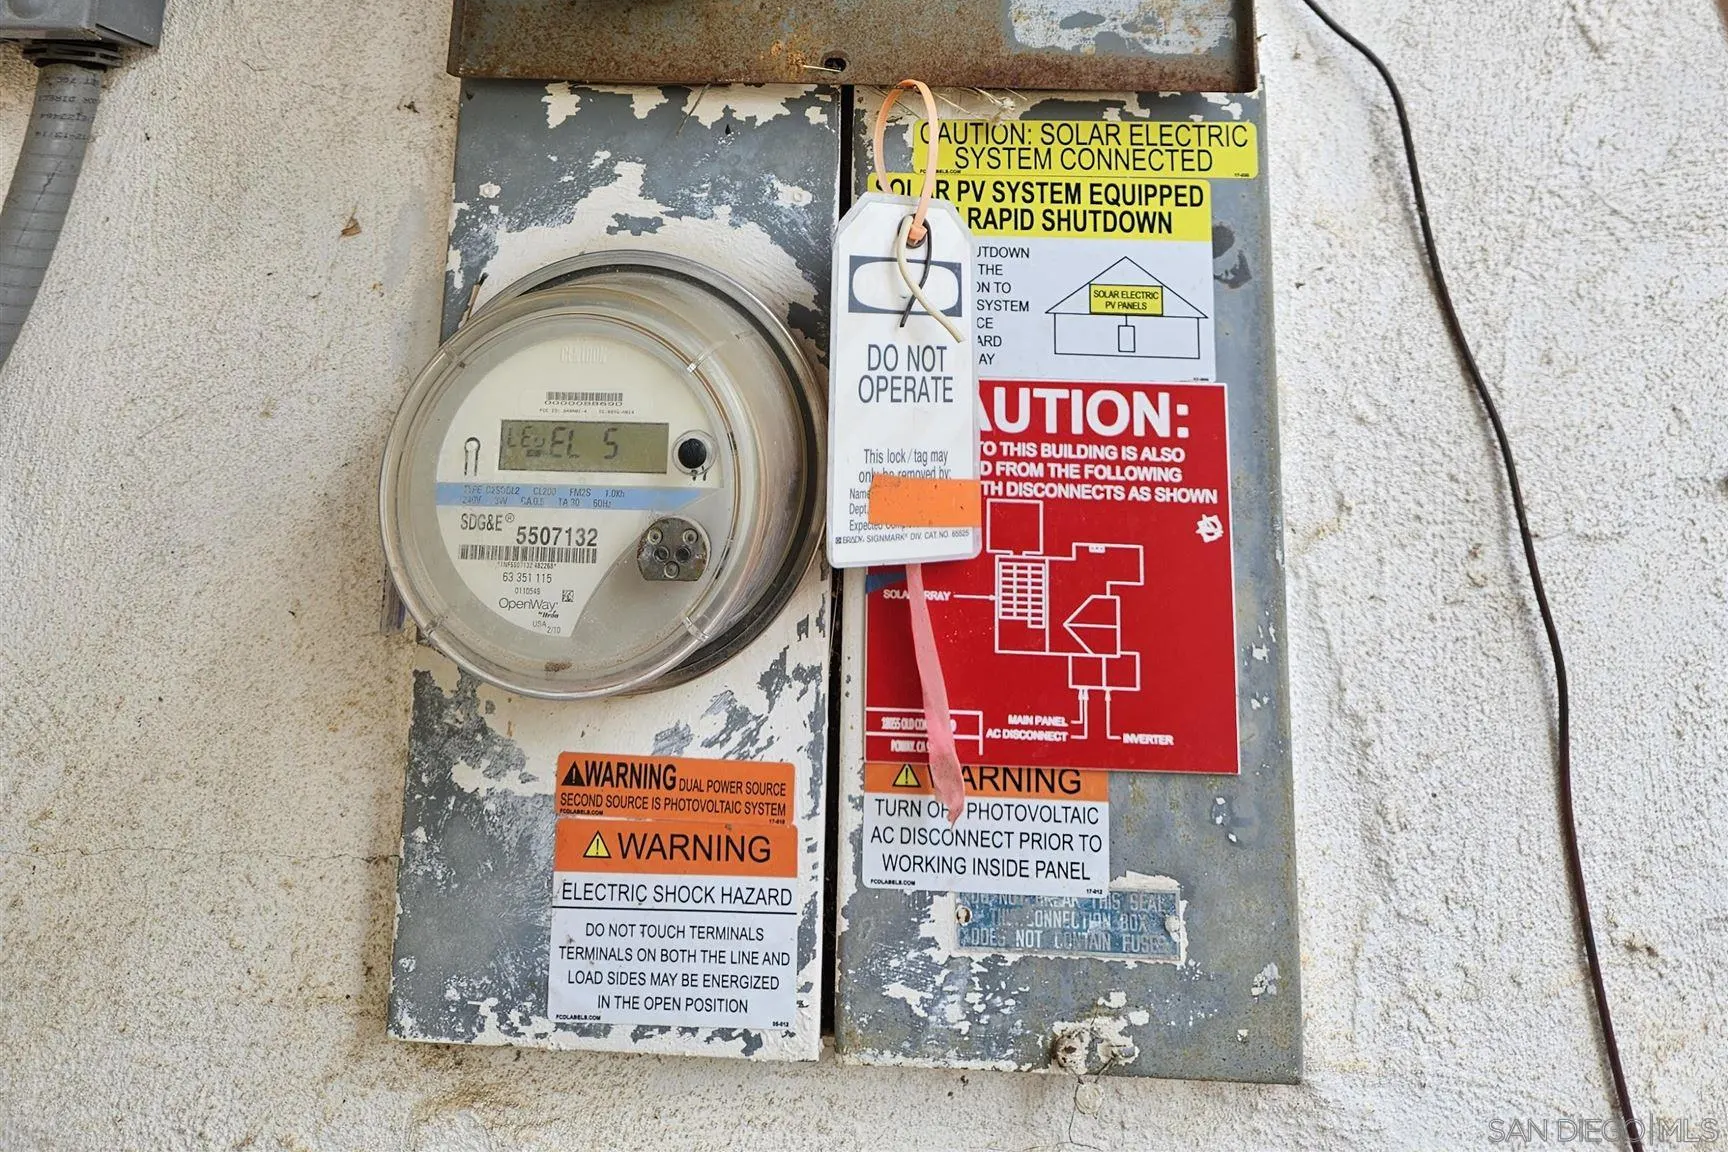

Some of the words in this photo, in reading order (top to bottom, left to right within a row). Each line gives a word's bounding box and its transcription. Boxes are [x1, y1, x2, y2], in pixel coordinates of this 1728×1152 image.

[920, 122, 1033, 145] CAUTION:
[1041, 122, 1126, 146] SOLAR
[1130, 124, 1249, 147] ELECTRIC
[955, 147, 1055, 170] SYSTEM
[1060, 149, 1213, 172] CONNECTED
[957, 181, 984, 202] PV
[992, 181, 1081, 205] SYSTEM
[1089, 183, 1204, 207] EQUIPPED
[968, 207, 1035, 230] RAPID
[1042, 209, 1173, 234] SHUTDOWN
[979, 264, 1003, 275] THE
[994, 282, 1011, 293] TO
[1093, 290, 1120, 299] SOLAR
[1121, 290, 1159, 300] ELECTRIC
[977, 300, 1030, 312] SYSTEM
[1105, 301, 1116, 309] PV
[1118, 302, 1147, 310] PANELS
[868, 344, 898, 372] DO
[907, 345, 947, 372] NOT
[858, 375, 953, 403] OPERATE
[979, 386, 1189, 439] AUTION:
[603, 427, 620, 460] 5
[1000, 442, 1037, 458] THIS
[1041, 443, 1118, 460] BUILDING
[1121, 446, 1138, 461] IS
[1140, 446, 1185, 463] ALSO
[864, 449, 883, 464] This
[887, 449, 905, 463] lock
[914, 450, 927, 466] tag
[931, 450, 948, 465] may
[859, 468, 875, 483] onl
[996, 462, 1044, 478] FROM
[1047, 463, 1081, 479] THE
[1084, 464, 1182, 482] FOLLOWING
[982, 481, 1003, 496] TH
[1006, 482, 1122, 501] DISCONNECTS
[1128, 488, 1152, 502] AS
[1155, 489, 1218, 504] SHOWN
[516, 526, 598, 547] 5507132
[503, 572, 513, 582] 63
[517, 573, 531, 582] 351
[883, 589, 910, 600] SOLA
[924, 590, 951, 601] RRAY
[1008, 714, 1033, 726] MAIN
[1035, 715, 1068, 726] PANEL
[986, 728, 1002, 739] AC
[1003, 729, 1068, 742] DISCONNECT
[1122, 733, 1174, 746] INVERTER
[585, 760, 677, 790] WARNING
[679, 779, 704, 792] DUAL
[707, 780, 743, 794] POWER
[745, 782, 787, 796] SOURCE
[930, 765, 1081, 794] ARNING
[560, 792, 603, 807] SECOND
[606, 795, 649, 810] SOURCE
[652, 798, 661, 810] IS
[664, 798, 741, 814] PHOTOVOLTAIC
[744, 803, 786, 817] SYSTEM
[875, 799, 921, 818] TURN
[967, 803, 1099, 825] PHOTOVOLTAIC
[618, 833, 771, 863] WARNING
[871, 826, 894, 843] AC
[901, 827, 1014, 848] DISCONNECT
[1020, 832, 1074, 851] PRIOR
[1079, 834, 1102, 852] TO
[882, 854, 966, 875] WORKING
[972, 858, 1029, 878] INSIDE
[1036, 861, 1090, 880] PANEL
[562, 882, 648, 902] ELECTRIC
[652, 885, 715, 904] SHOCK
[721, 887, 792, 906] HAZARD
[1091, 892, 1121, 910] THIS
[1130, 893, 1166, 913] SEAL
[586, 922, 605, 936] DO
[609, 924, 636, 937] NOT
[640, 924, 685, 939] TOUCH
[690, 925, 764, 942] TERMINALS
[1121, 912, 1147, 932] BOX
[1016, 929, 1043, 948] NOT
[1054, 931, 1112, 952] CONTAIN
[559, 946, 633, 962] TERMINALS
[637, 948, 656, 962] ON
[661, 948, 696, 963] BOTH
[701, 950, 726, 964] THE
[731, 950, 759, 965] LINE
[762, 952, 790, 966] AND
[568, 970, 603, 984] LOAD
[607, 971, 646, 986] SIDES
[650, 972, 678, 987] MAY
[682, 973, 698, 987] BE
[703, 974, 779, 990] ENERGIZED
[598, 995, 610, 1009] IN
[615, 996, 639, 1010] THE
[644, 996, 681, 1011] OPEN
[685, 998, 748, 1013] POSITION
